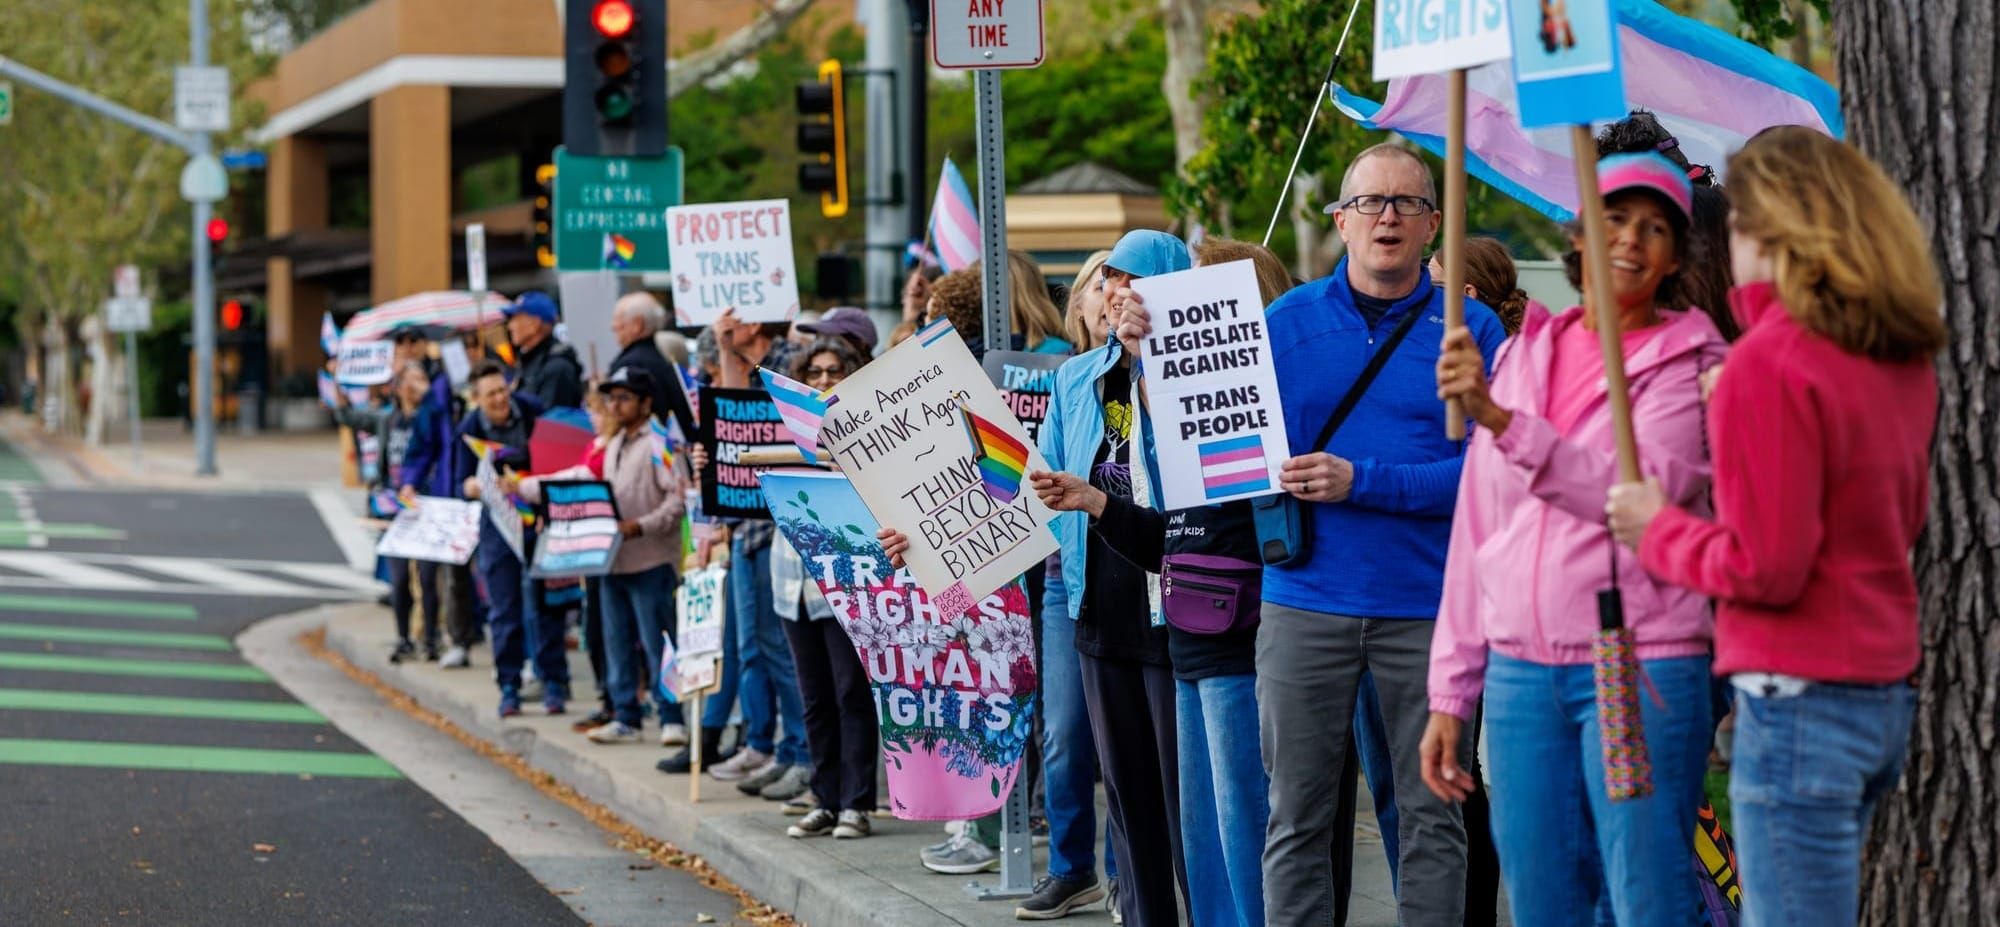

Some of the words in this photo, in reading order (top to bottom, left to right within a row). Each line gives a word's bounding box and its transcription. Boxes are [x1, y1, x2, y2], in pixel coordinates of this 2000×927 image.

[968, 0, 1004, 18] ANY
[968, 24, 1008, 48] TIME
[675, 207, 784, 246] PROTECT
[696, 251, 760, 278] TRANS
[699, 281, 766, 308] LIVES
[1168, 299, 1239, 329] DON'T
[1149, 321, 1262, 357] LEGISLATE
[1003, 363, 1055, 393] TRAN
[1162, 347, 1260, 380] AGAINST
[715, 397, 767, 421] TRANS
[823, 410, 873, 446] Make
[875, 364, 944, 413] America
[1179, 385, 1260, 415] TRANS
[715, 419, 774, 443] RIGHTS
[839, 408, 921, 471] THINK
[1179, 409, 1269, 441] PEOPLE
[716, 463, 768, 487] HUMA
[716, 485, 767, 510] RIGHT
[918, 483, 1021, 550] BEYO
[1184, 526, 1206, 537] KIDS
[940, 496, 1037, 580] BINARY
[825, 589, 1005, 626] RIGHS
[932, 580, 963, 607] FIGHT
[940, 591, 969, 613] BOOK
[946, 601, 971, 621] BANS
[857, 645, 1011, 690] UMAN
